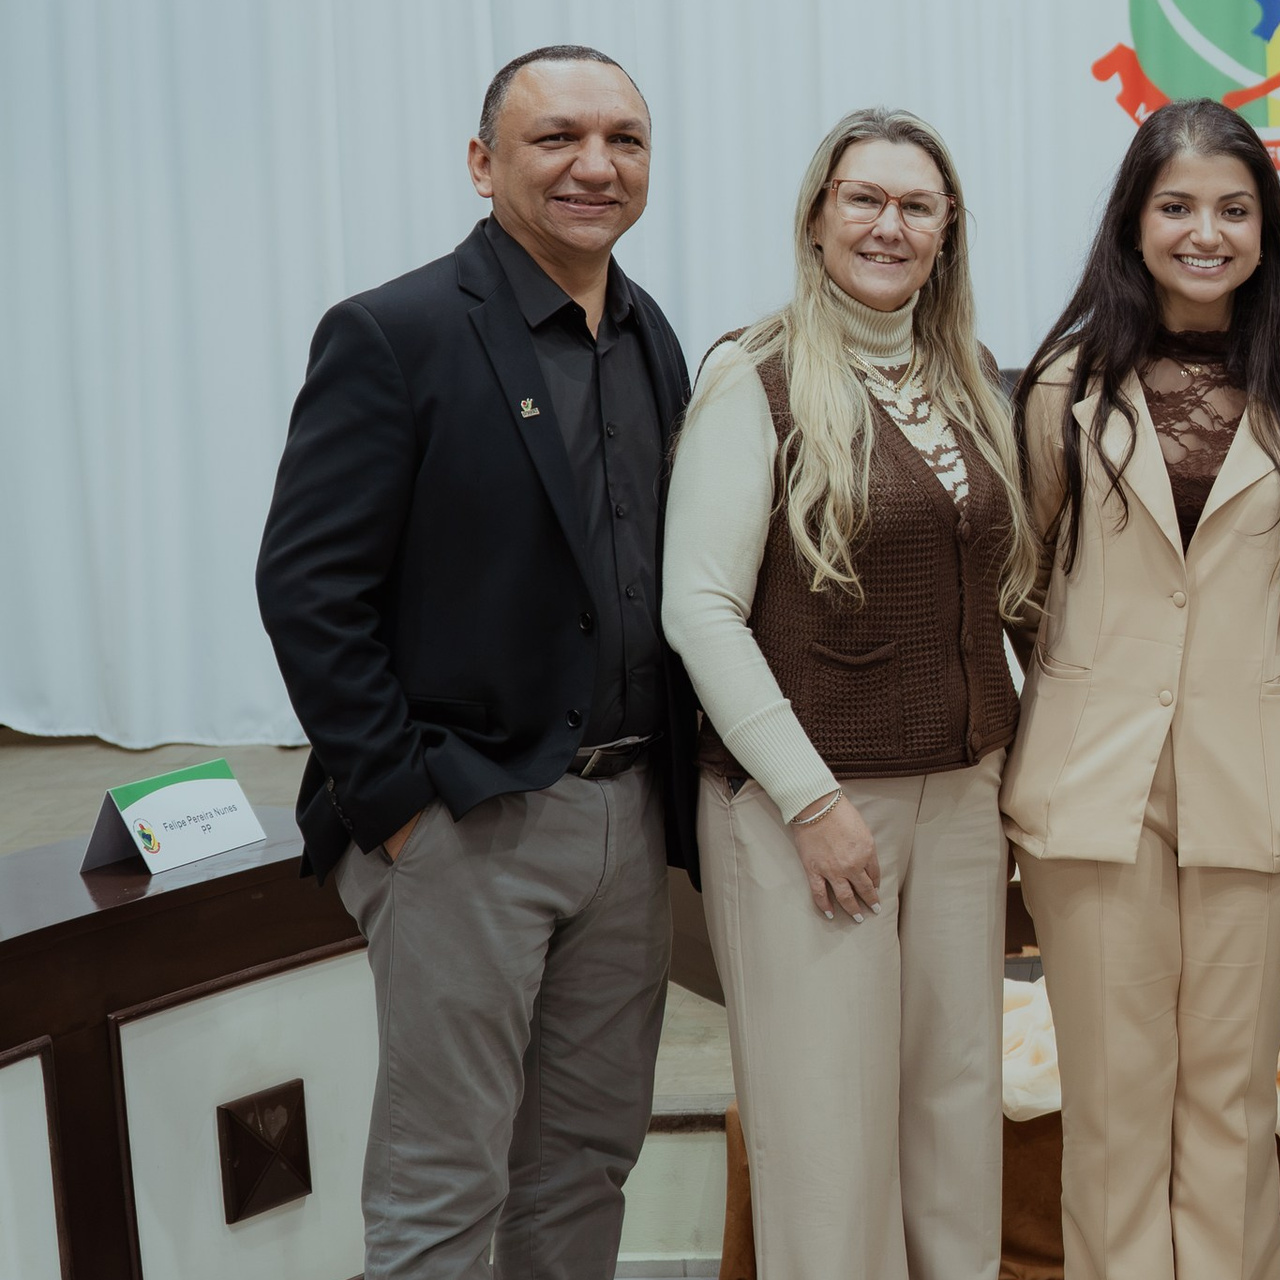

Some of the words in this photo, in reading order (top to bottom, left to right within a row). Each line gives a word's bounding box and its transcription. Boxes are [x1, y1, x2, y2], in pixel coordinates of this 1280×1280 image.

[162, 819, 187, 832] Felipe
[186, 811, 214, 824] Pereira
[213, 804, 238, 817] Nunes
